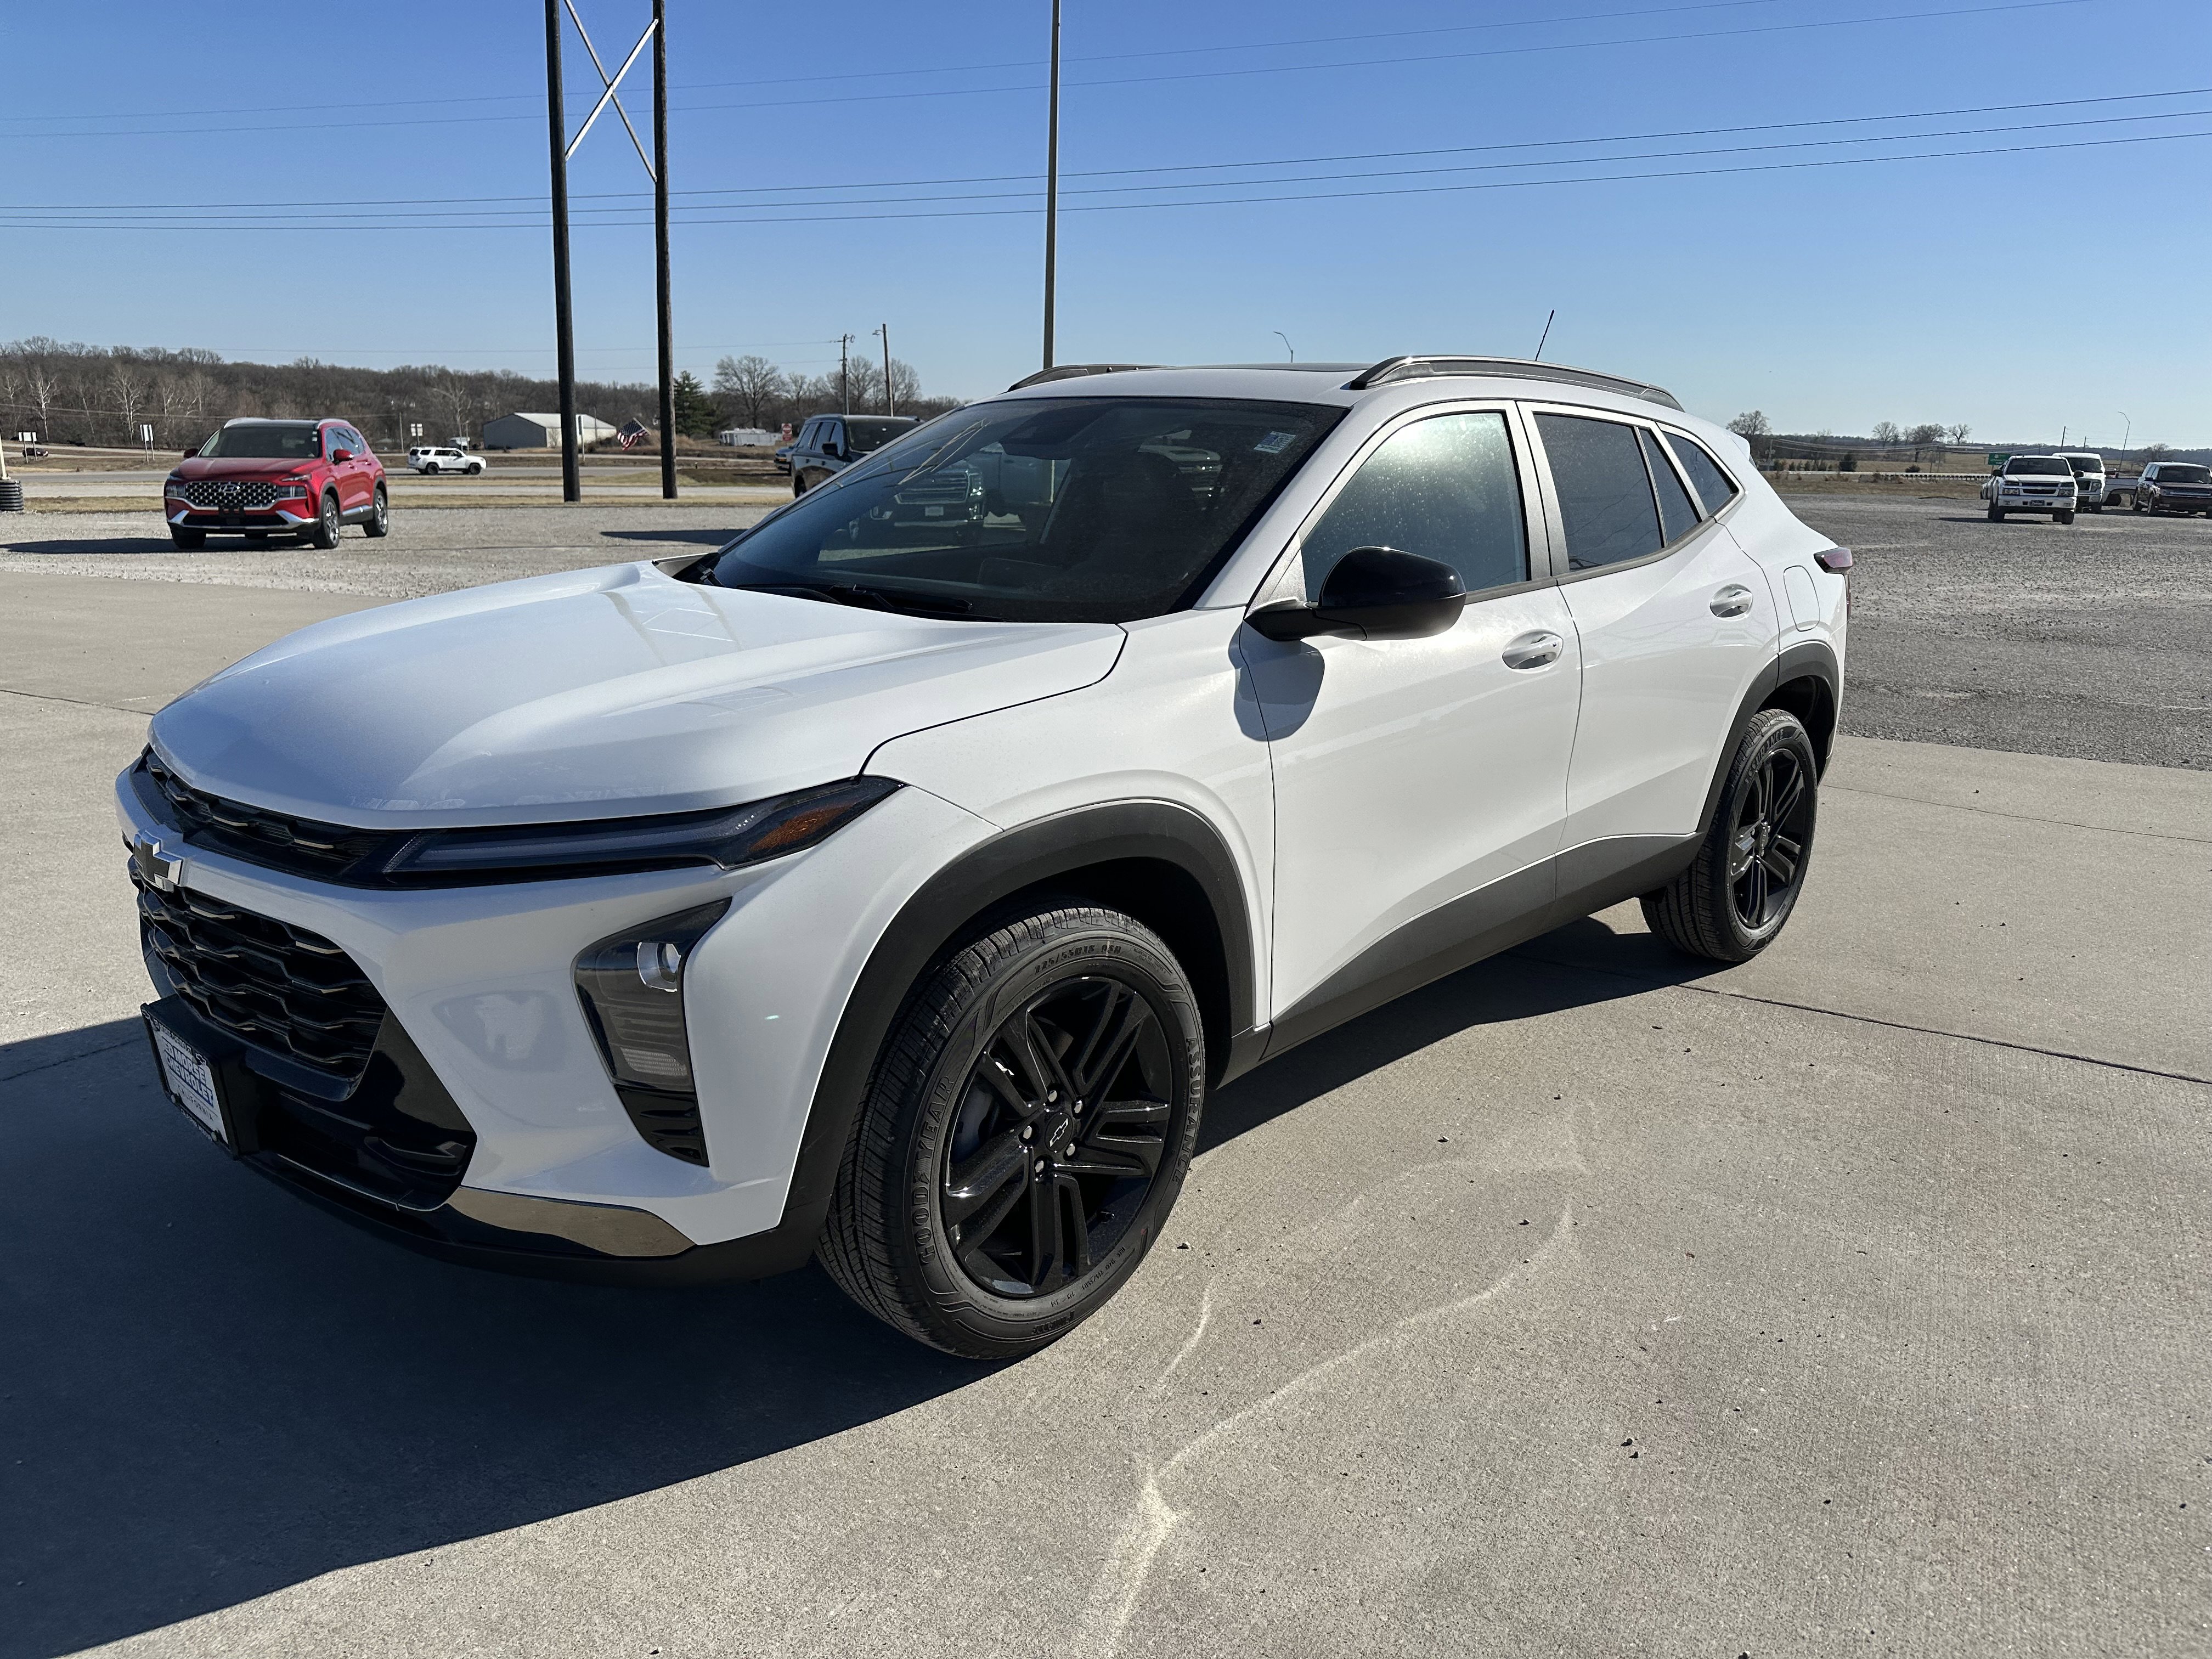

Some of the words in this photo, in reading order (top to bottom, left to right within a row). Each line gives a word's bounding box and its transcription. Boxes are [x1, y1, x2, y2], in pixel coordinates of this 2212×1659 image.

[163, 1039, 175, 1059] ED
[173, 1045, 207, 1086] MORSE
[165, 1051, 215, 1108] CHEVROLET
[177, 1084, 214, 1121] CALIFORNIA
[1171, 1037, 1201, 1184] ASSURANCE
